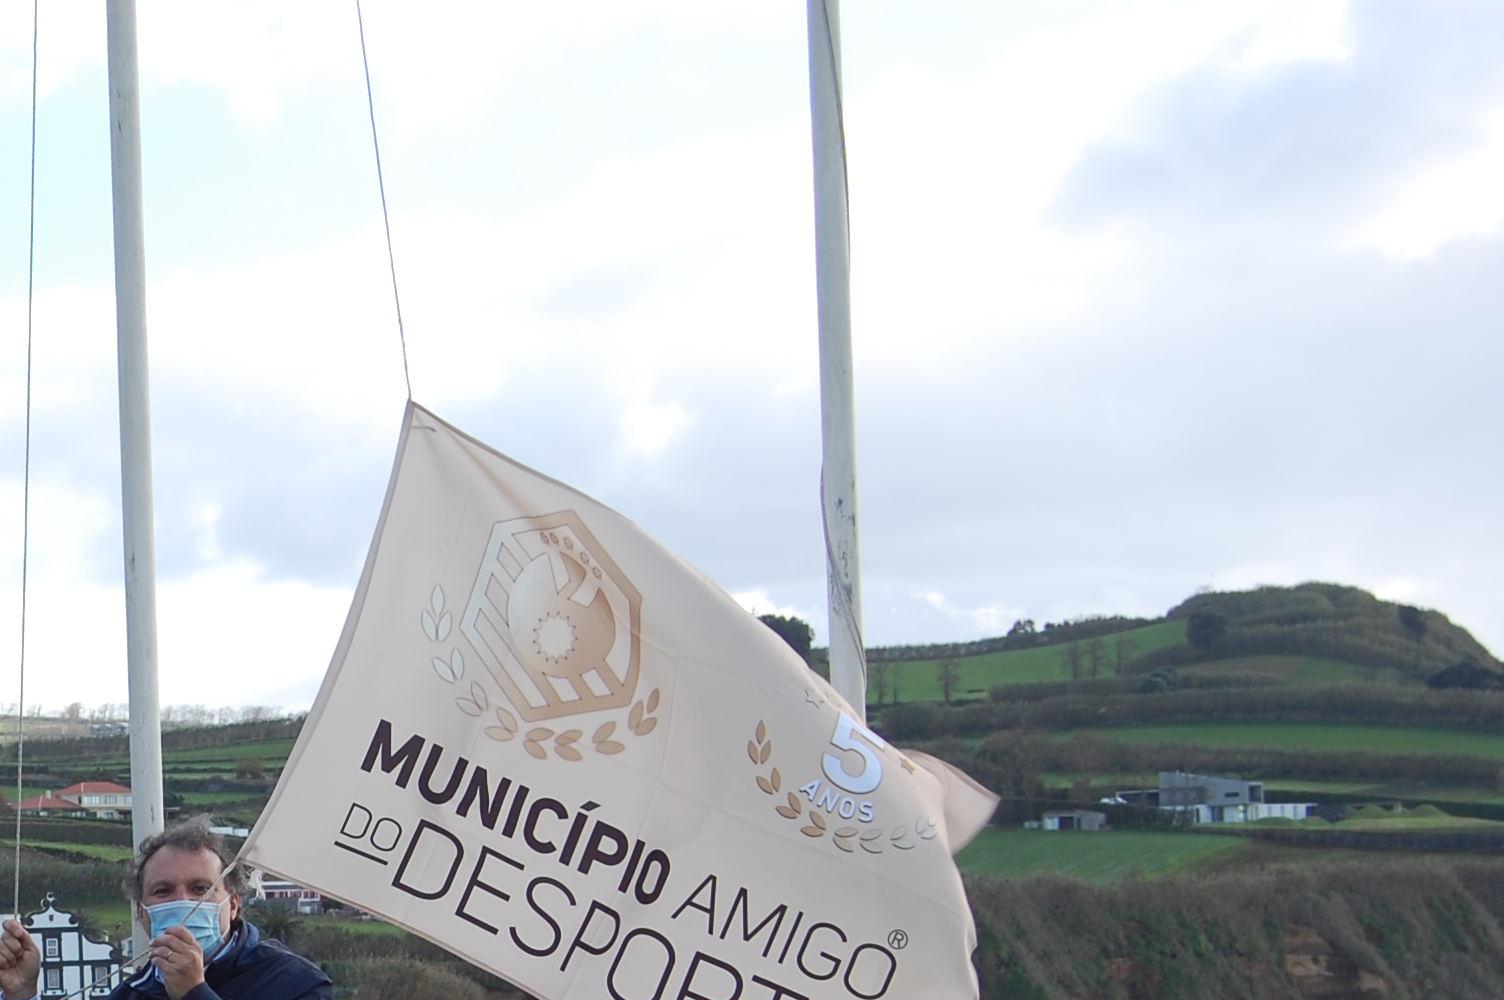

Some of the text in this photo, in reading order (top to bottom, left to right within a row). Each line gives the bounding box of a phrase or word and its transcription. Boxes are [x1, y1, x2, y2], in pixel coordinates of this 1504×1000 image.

[821, 711, 885, 795] 5
[339, 802, 403, 852] DO
[360, 718, 671, 906] MUNICÍPIO
[798, 778, 876, 824] ANOS
